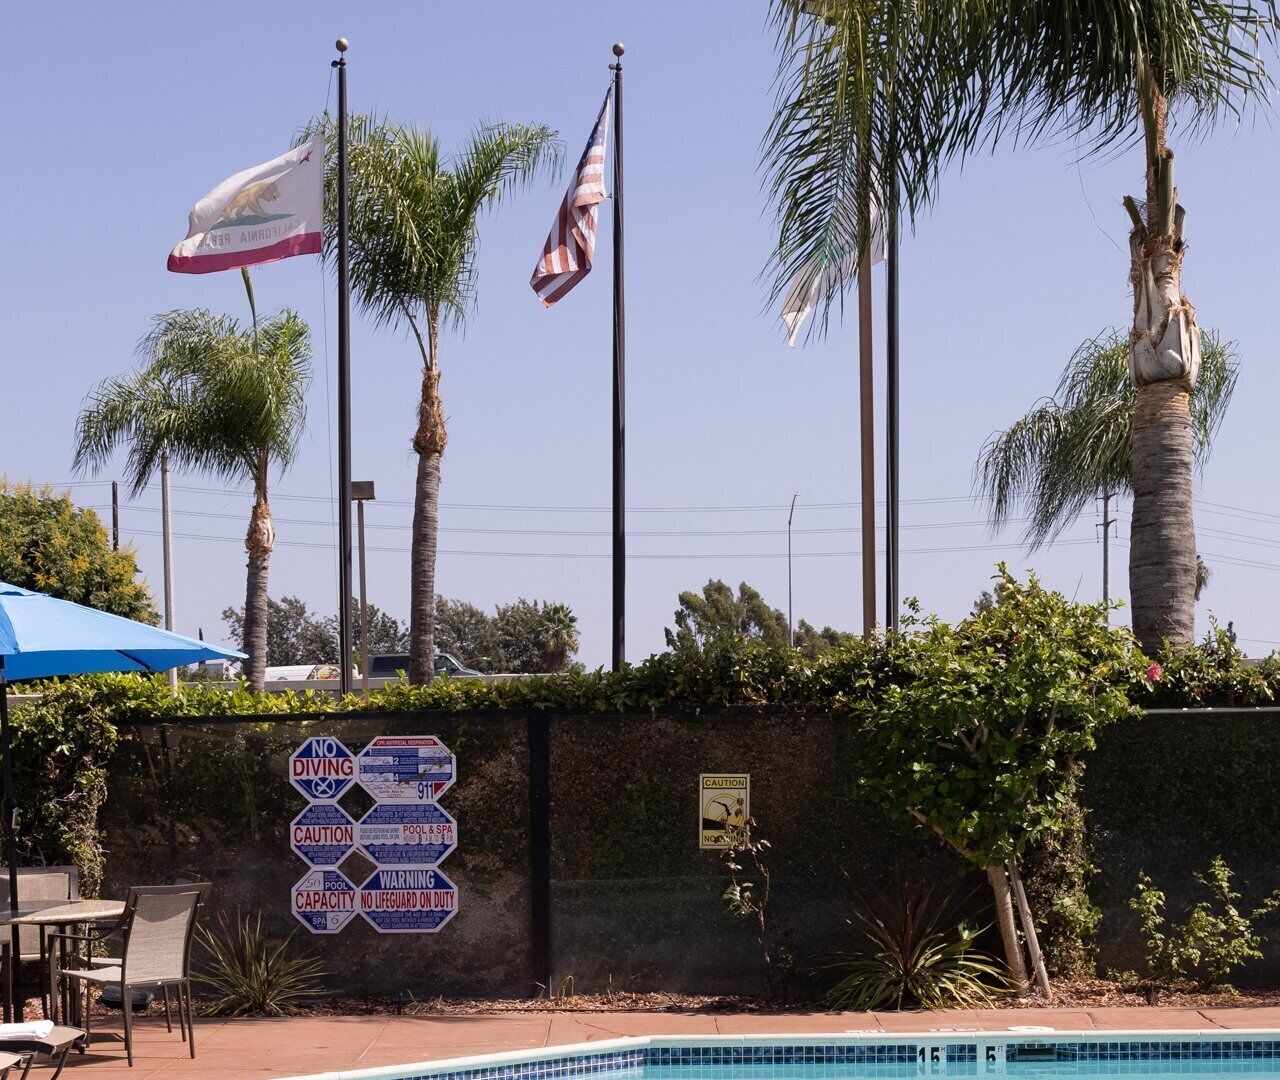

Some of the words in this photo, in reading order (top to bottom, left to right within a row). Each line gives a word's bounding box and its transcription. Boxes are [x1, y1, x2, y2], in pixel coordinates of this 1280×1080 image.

[312, 739, 336, 757] NO
[294, 758, 353, 776] DIVING
[418, 782, 434, 800] 911
[294, 827, 353, 843] CAUTION
[403, 825, 426, 834] POOL
[428, 825, 434, 834] &
[436, 825, 453, 834] SPA
[306, 879, 320, 888] 50
[380, 871, 434, 889] WARNING
[296, 892, 355, 909] CAPACITY
[361, 891, 372, 908] NO
[376, 891, 417, 908] LIFEGUARD
[420, 891, 431, 908] ON
[434, 891, 454, 908] DUTY
[331, 915, 339, 924] 6
[986, 1046, 996, 1062] 5
